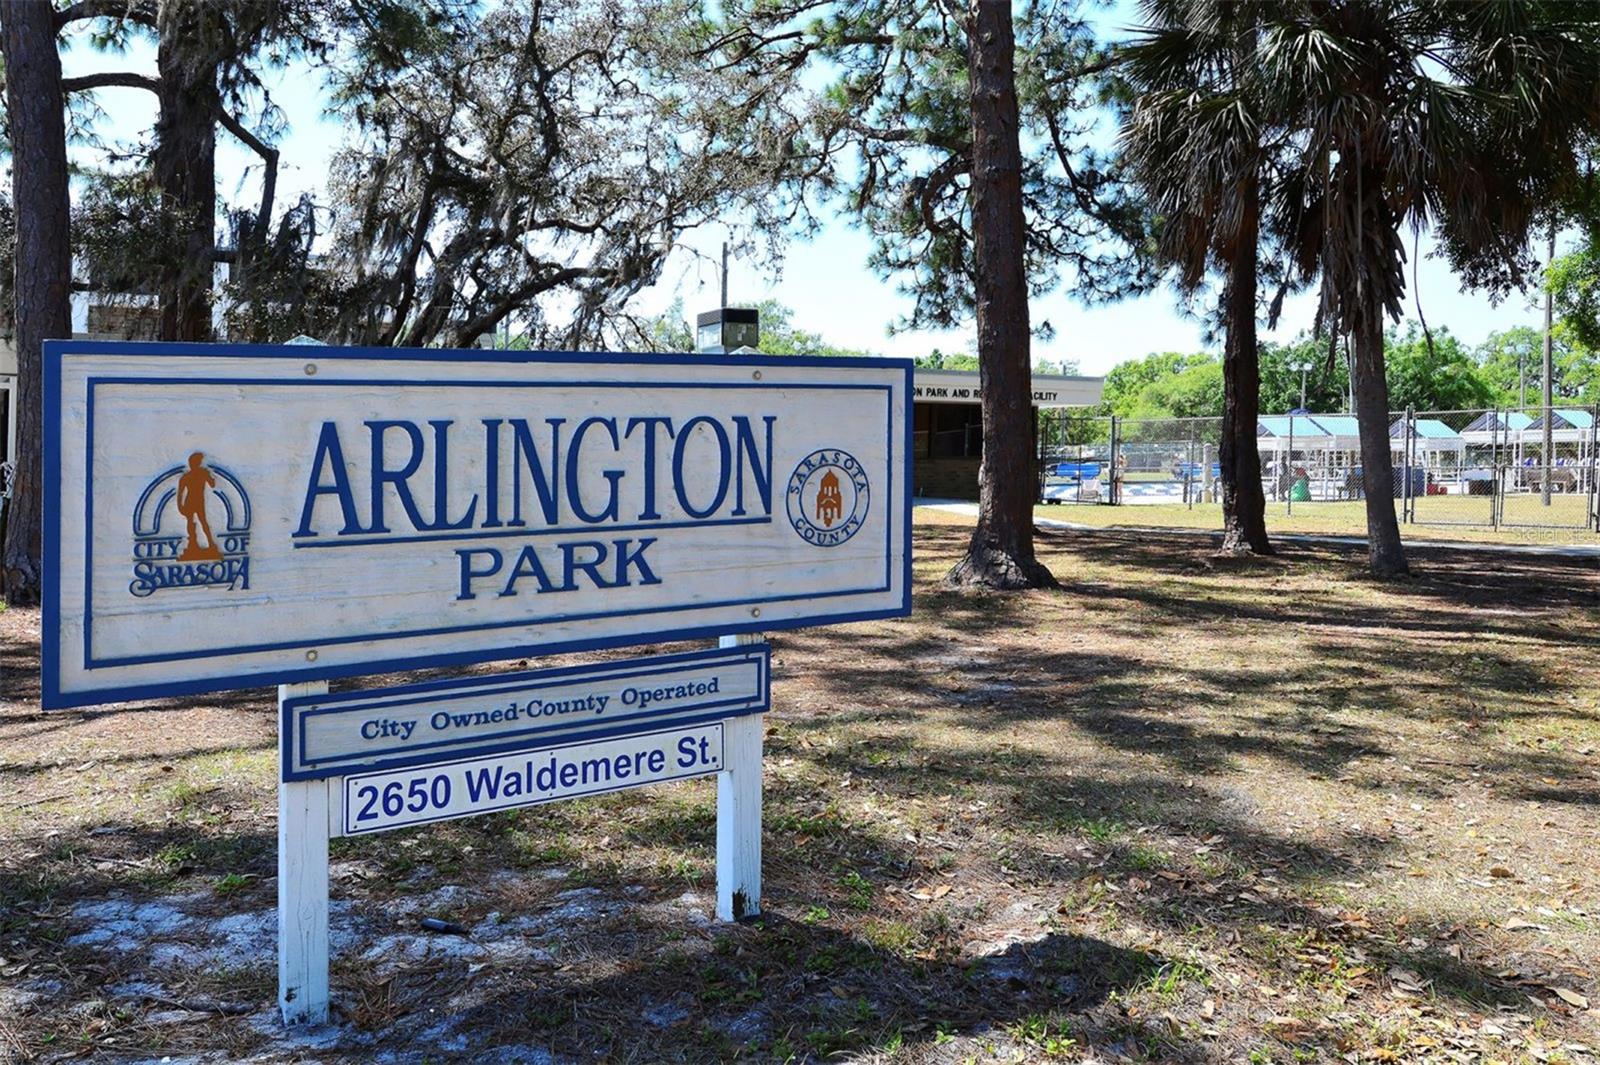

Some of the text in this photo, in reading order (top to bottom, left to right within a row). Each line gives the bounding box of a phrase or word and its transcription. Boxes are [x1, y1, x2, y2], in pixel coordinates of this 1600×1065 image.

[926, 387, 948, 398] PARK
[952, 388, 970, 398] AND
[291, 415, 777, 537] ARLINGTON
[790, 452, 867, 495] SARASOTA
[133, 537, 250, 558] CITY OF
[795, 514, 860, 544] COUNTY
[129, 557, 250, 597] SARASOTA
[455, 538, 662, 600] PARK
[361, 677, 720, 740] City Owned-County Operated
[356, 736, 718, 821] 2650 Waldemere St.
